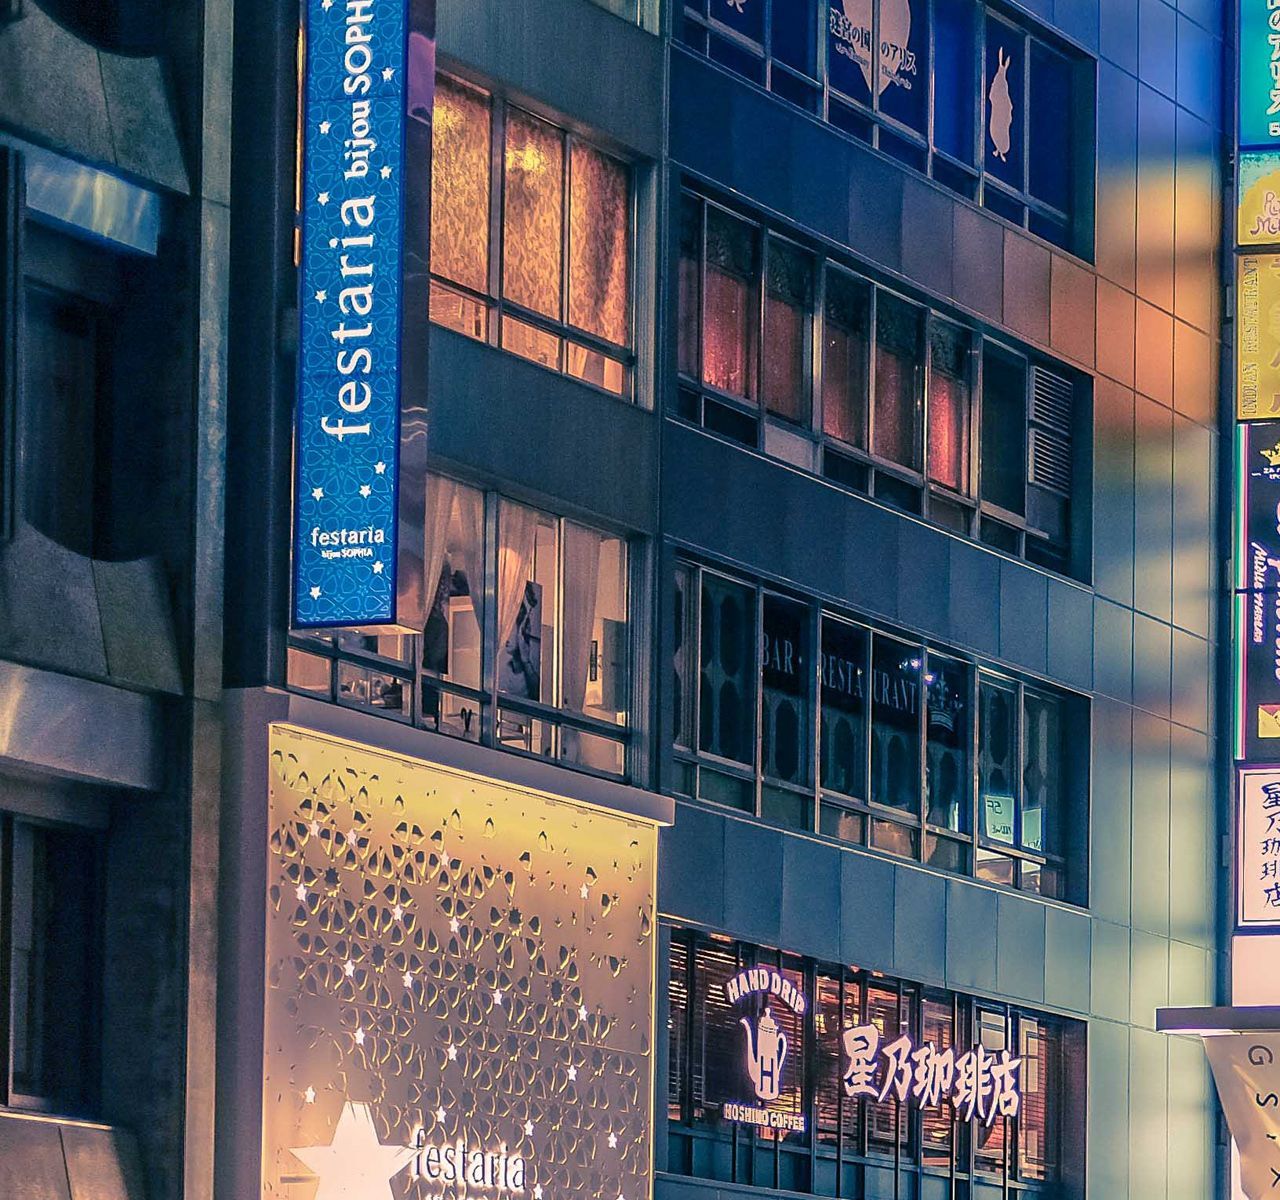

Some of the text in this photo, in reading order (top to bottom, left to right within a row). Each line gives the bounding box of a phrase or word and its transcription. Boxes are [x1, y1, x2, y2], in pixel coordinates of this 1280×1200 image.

[344, 101, 377, 180] bijou
[322, 195, 376, 441] festaria
[311, 526, 385, 546] festaria
[341, 547, 374, 558] SOPHIA
[763, 633, 918, 716] BAR RESTAURANT
[727, 968, 807, 1014] HAND DRIP
[842, 1023, 1022, 1128] 星乃珈琲店
[769, 1112, 806, 1133] COFFEE
[411, 1126, 527, 1193] festaria
